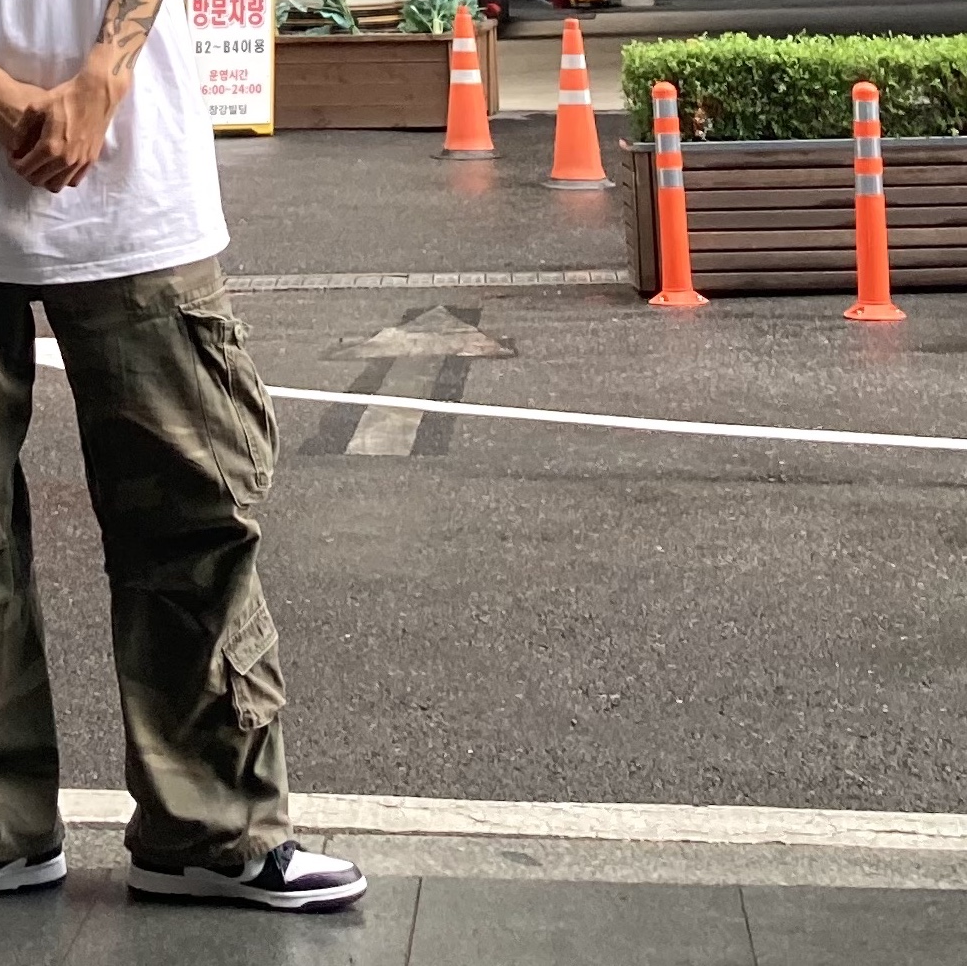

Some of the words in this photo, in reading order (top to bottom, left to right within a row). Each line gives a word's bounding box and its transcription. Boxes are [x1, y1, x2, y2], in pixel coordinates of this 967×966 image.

[209, 69, 248, 82] 운영시간
[200, 84, 262, 95] 6:00~24:00
[209, 104, 248, 115] 창강빌딩
